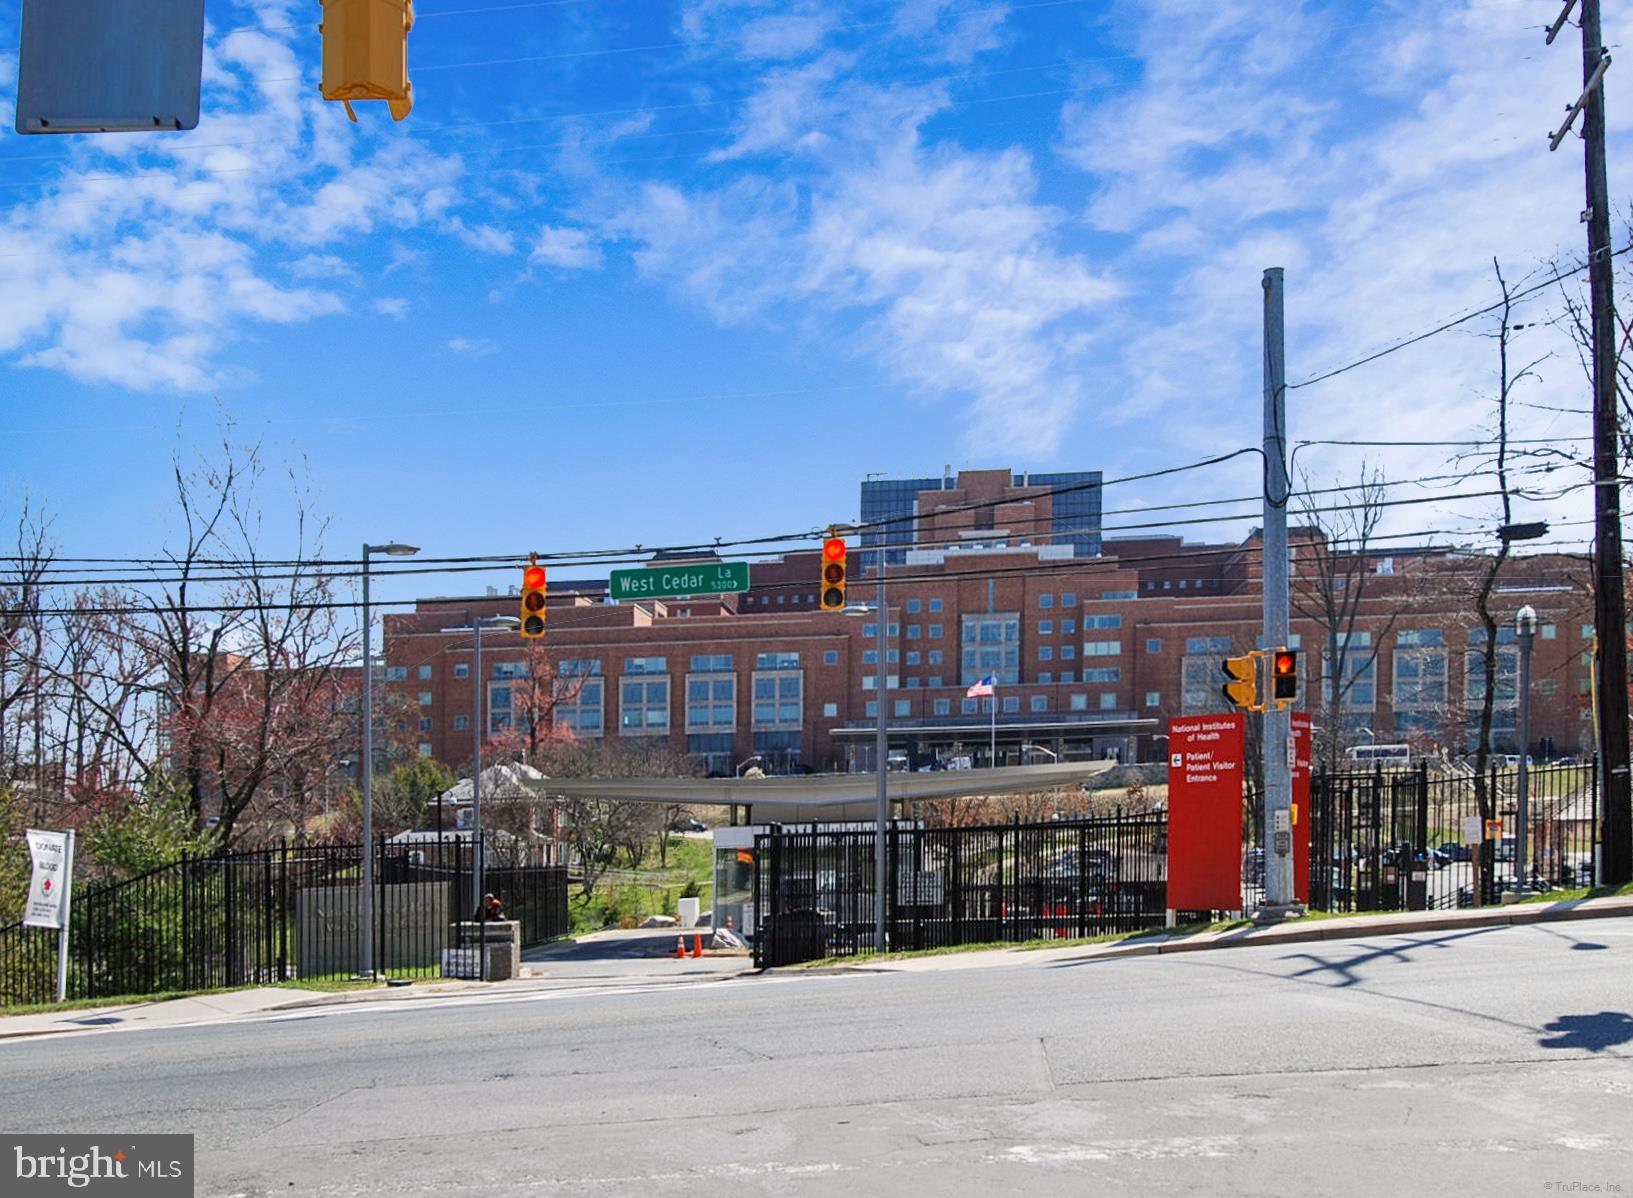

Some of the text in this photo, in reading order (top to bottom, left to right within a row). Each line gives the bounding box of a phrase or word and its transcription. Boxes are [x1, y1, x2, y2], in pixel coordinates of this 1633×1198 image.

[620, 567, 732, 592] West Cedar La
[1172, 721, 1236, 733] National Institutes
[1187, 732, 1220, 742] of Health
[1186, 751, 1214, 760] Patient/
[1186, 761, 1236, 771] Patient Visitor
[1186, 774, 1217, 783] Entrance
